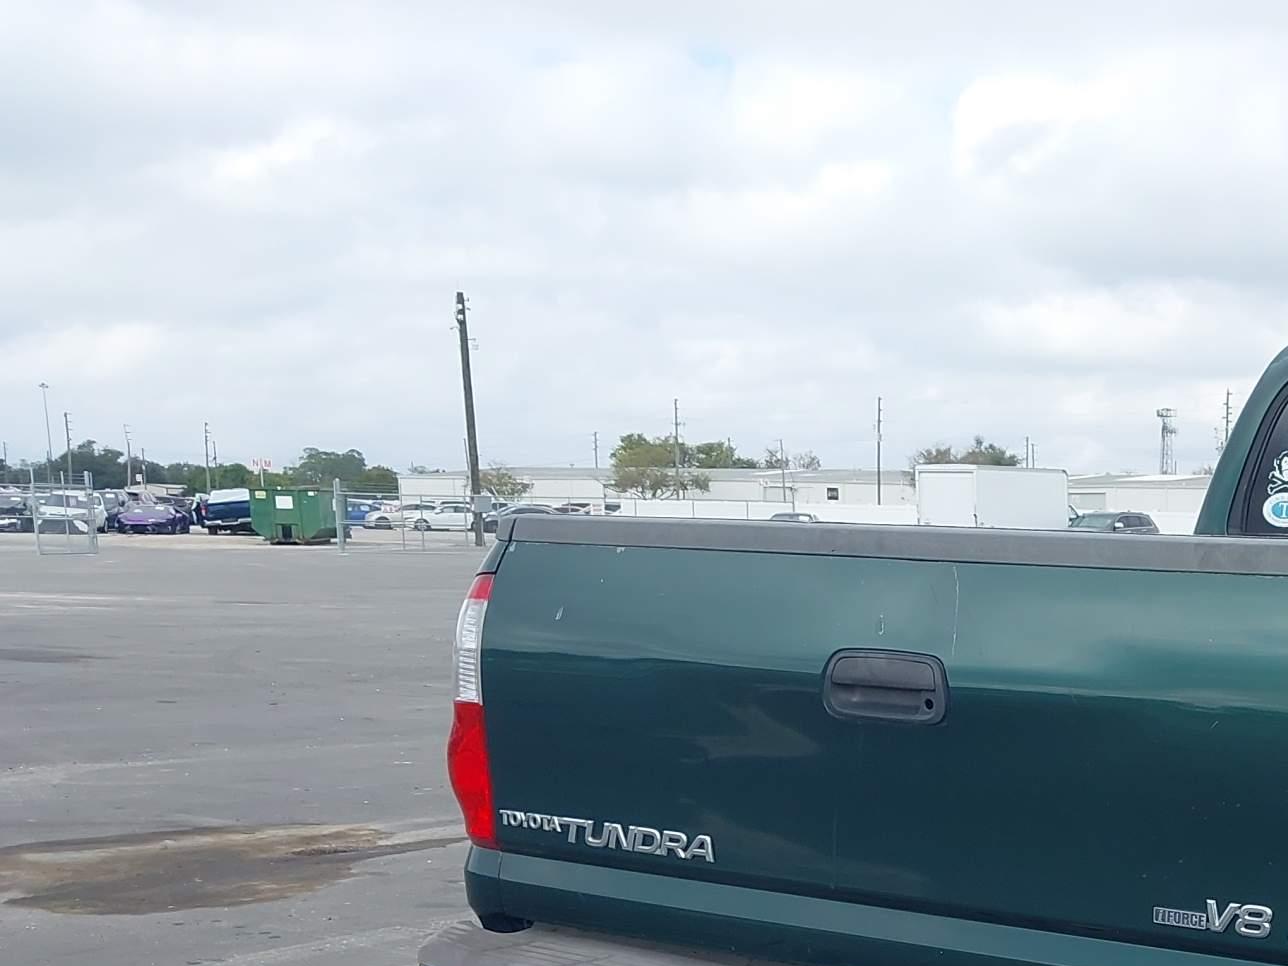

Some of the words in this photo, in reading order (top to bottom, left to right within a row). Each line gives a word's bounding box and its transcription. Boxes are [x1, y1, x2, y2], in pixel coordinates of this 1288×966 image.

[499, 809, 562, 832] TOYOTA
[557, 816, 715, 863] TUNDRA
[1206, 899, 1273, 939] V8
